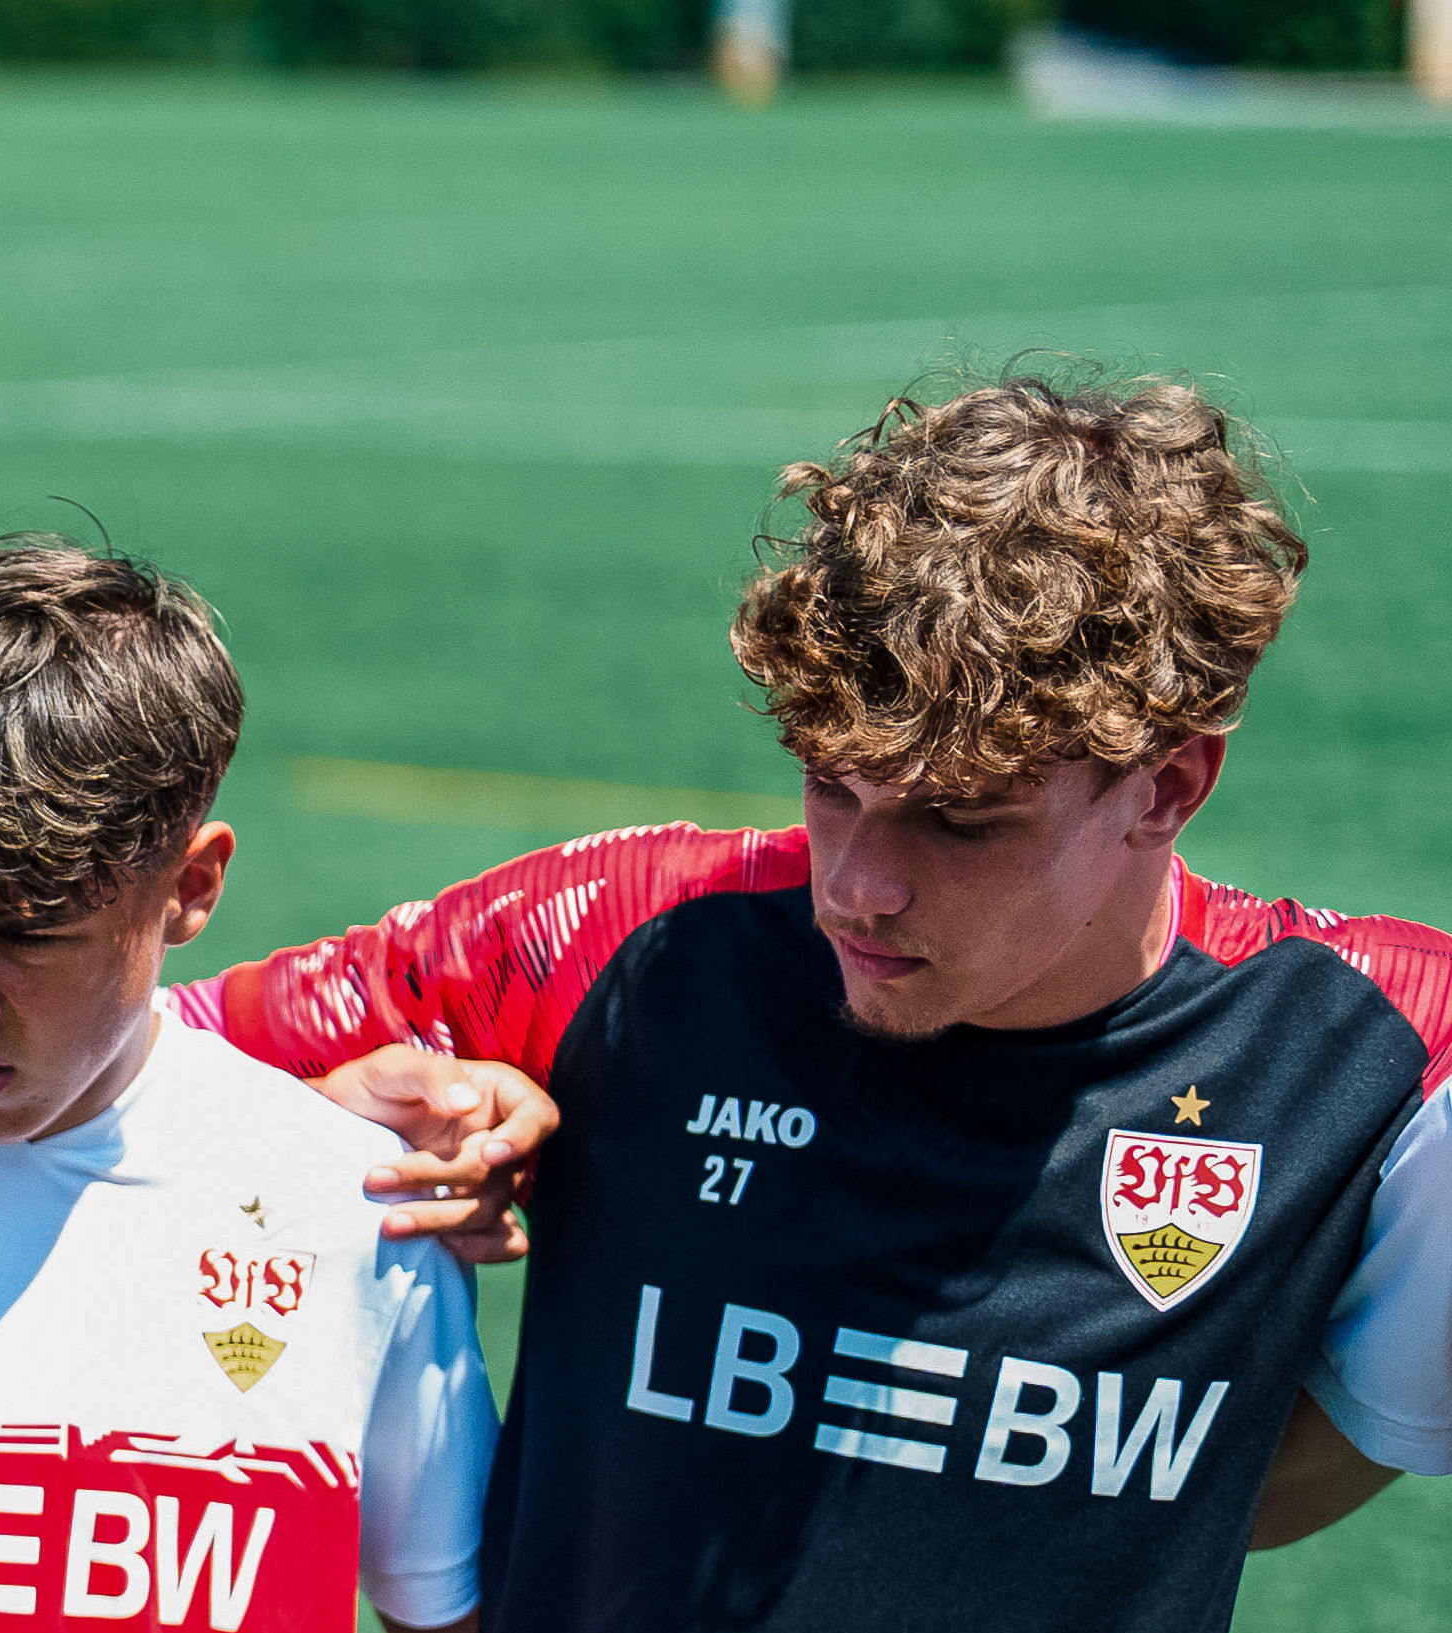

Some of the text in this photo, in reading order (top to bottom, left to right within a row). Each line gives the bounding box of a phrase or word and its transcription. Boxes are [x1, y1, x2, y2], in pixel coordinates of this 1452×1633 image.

[686, 1094, 816, 1149] JAKO
[698, 1155, 755, 1206] 27
[1112, 1145, 1247, 1218] VfB
